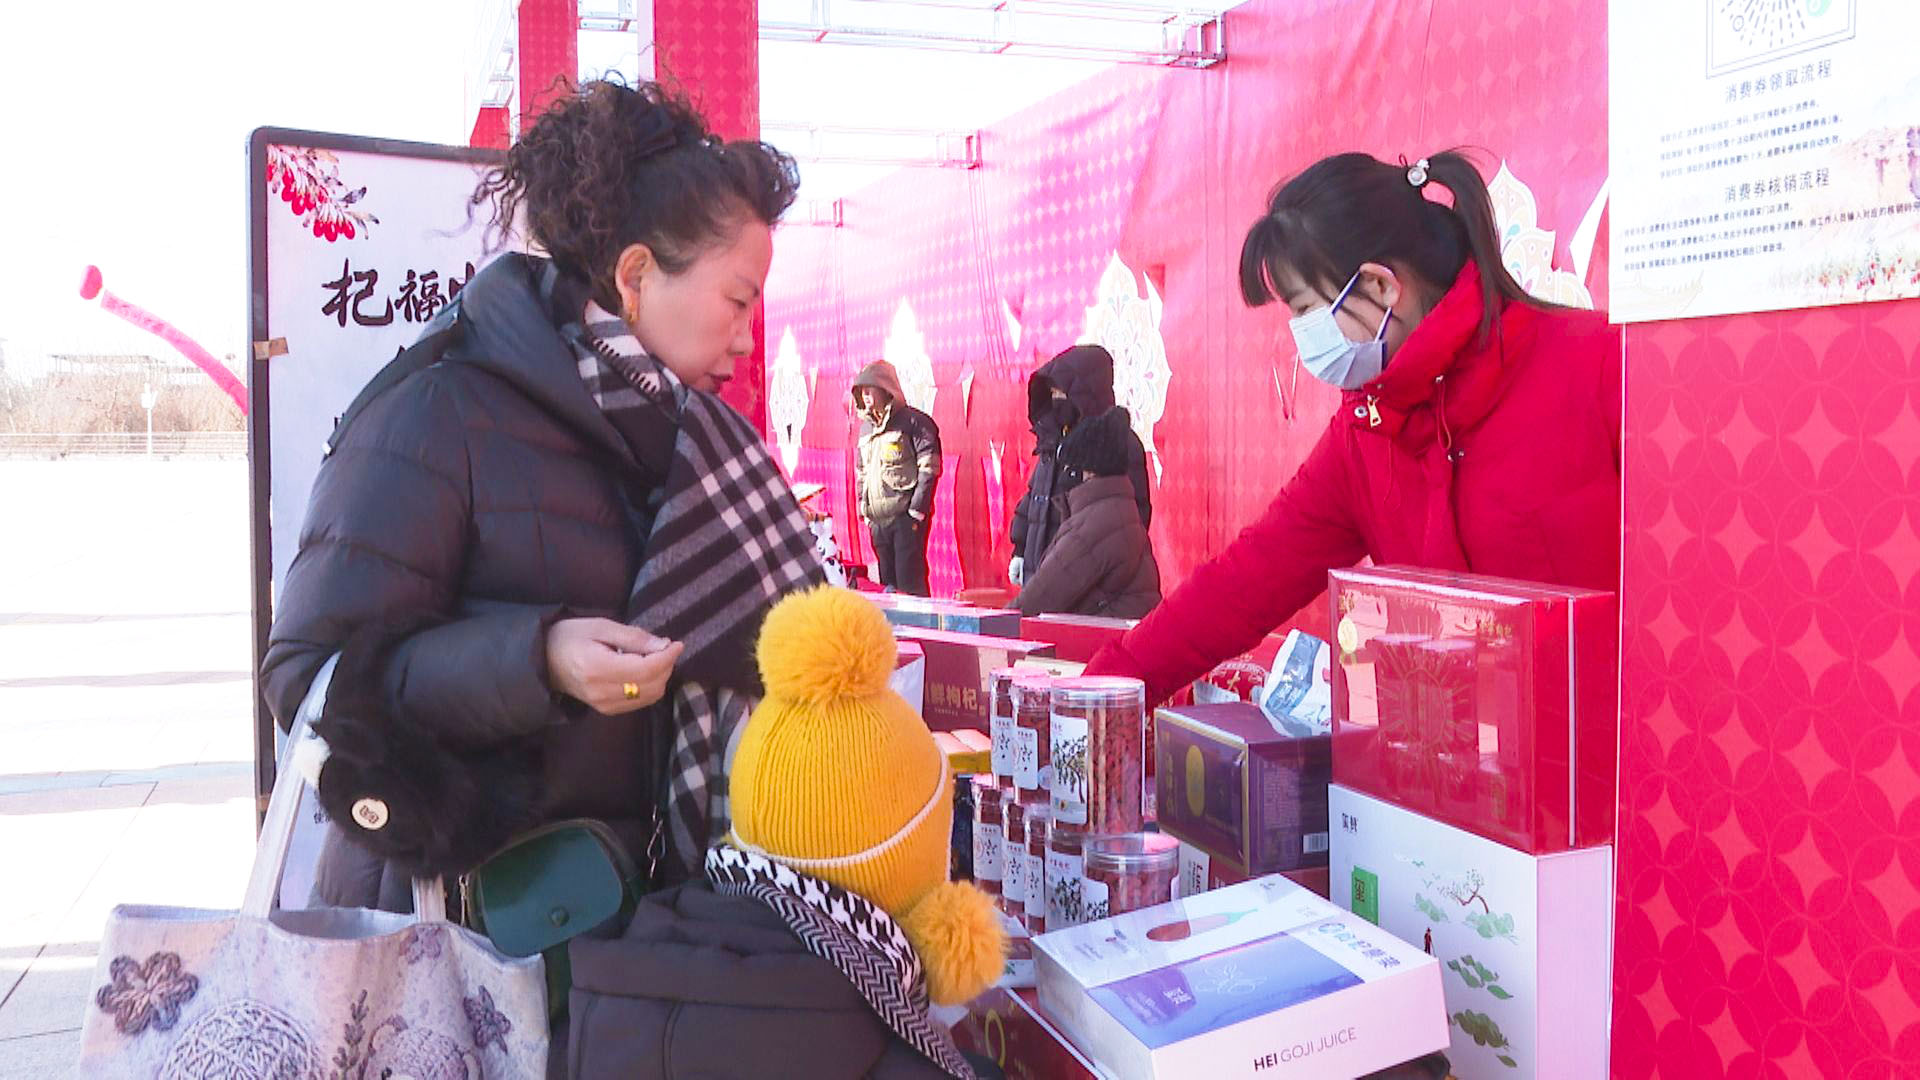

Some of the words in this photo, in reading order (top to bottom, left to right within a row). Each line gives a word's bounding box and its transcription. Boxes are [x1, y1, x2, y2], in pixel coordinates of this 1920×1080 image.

[1725, 58, 1832, 104] 消费券领取流程
[1725, 168, 1830, 203] 消费券核销流程
[1254, 1052, 1278, 1072] HEI
[1280, 1041, 1314, 1062] GOJI
[1317, 1026, 1357, 1053] JUICE
